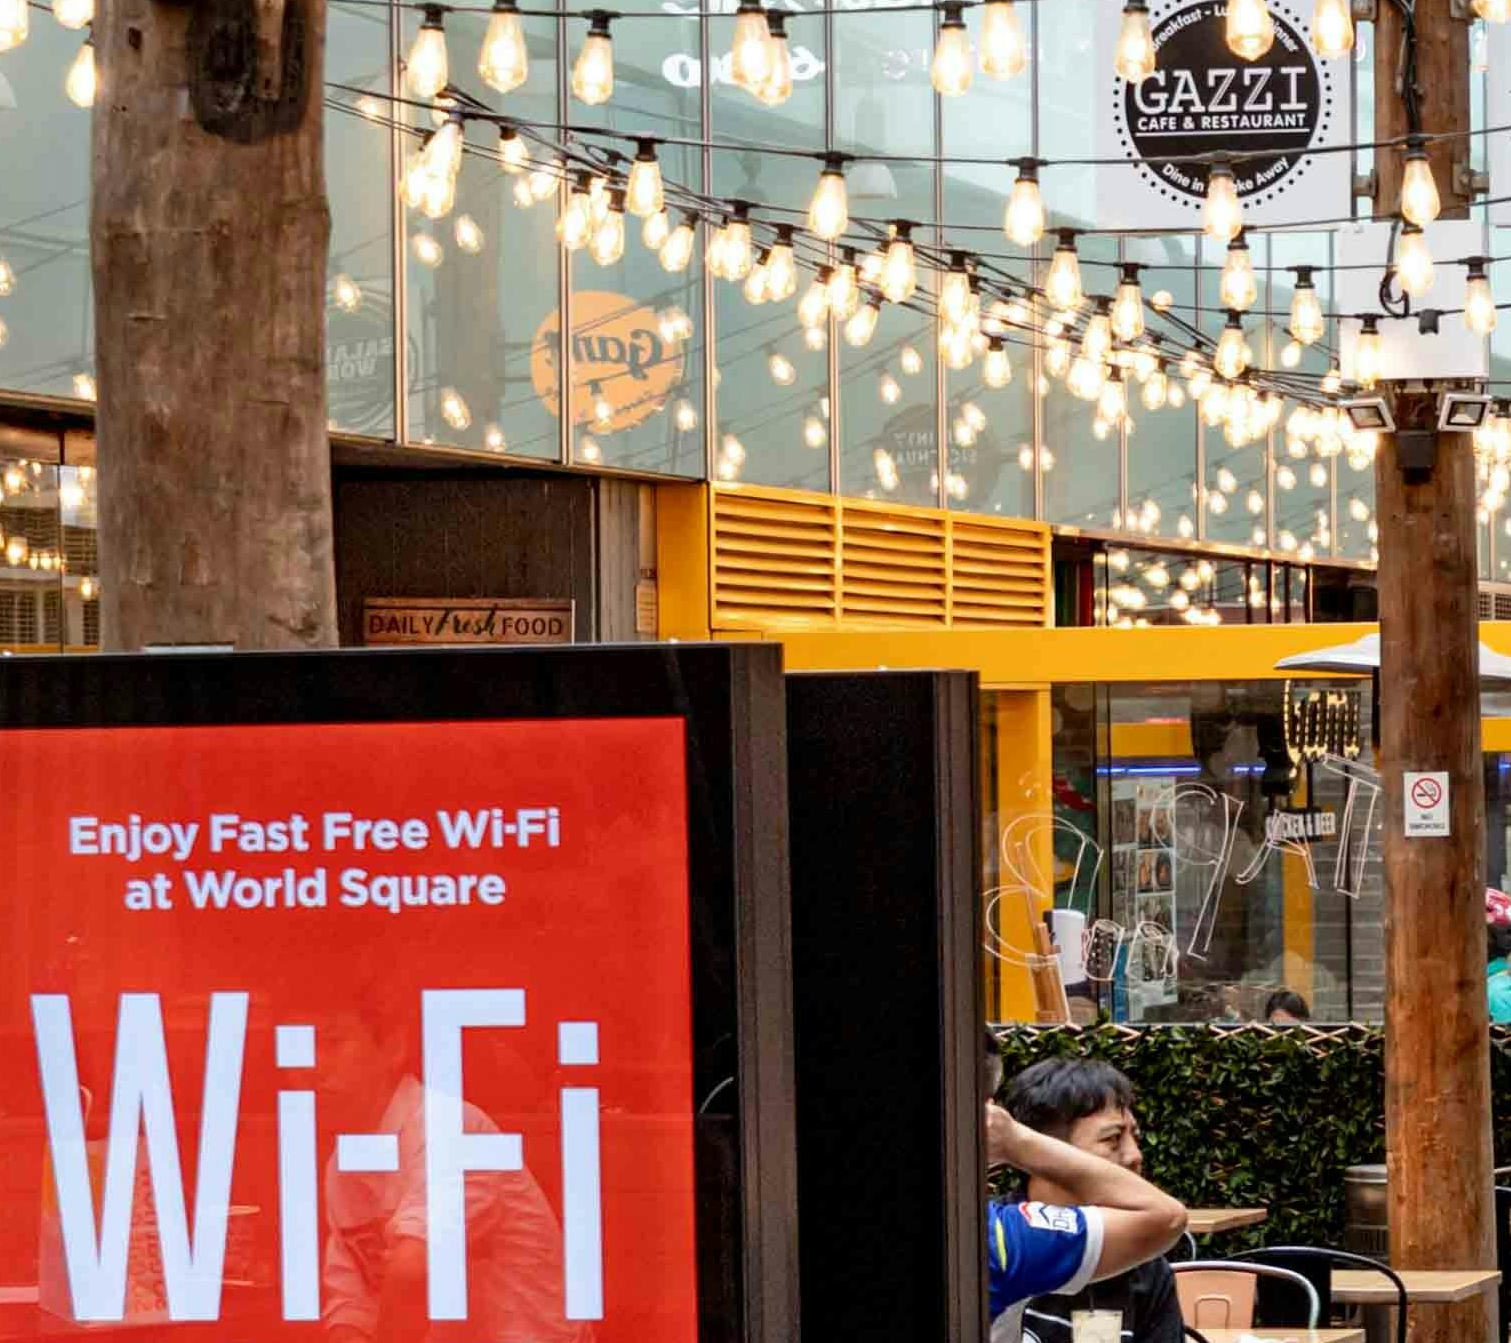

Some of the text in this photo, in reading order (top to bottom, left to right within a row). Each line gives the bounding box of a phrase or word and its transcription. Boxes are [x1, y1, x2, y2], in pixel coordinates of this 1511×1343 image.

[1151, 8, 1203, 52] reakfast
[1134, 66, 1308, 115] GAZZI
[1137, 113, 1307, 131] CAFE & RESTAURANT
[1162, 162, 1190, 188] Dine
[1255, 155, 1291, 188] Away
[369, 615, 433, 634] DAILY
[501, 617, 563, 636] FOOD
[69, 808, 560, 861] Enjoy Fast Free Wi-Fi
[124, 868, 506, 913] at World Square
[29, 989, 606, 1322] Wi-Fi
